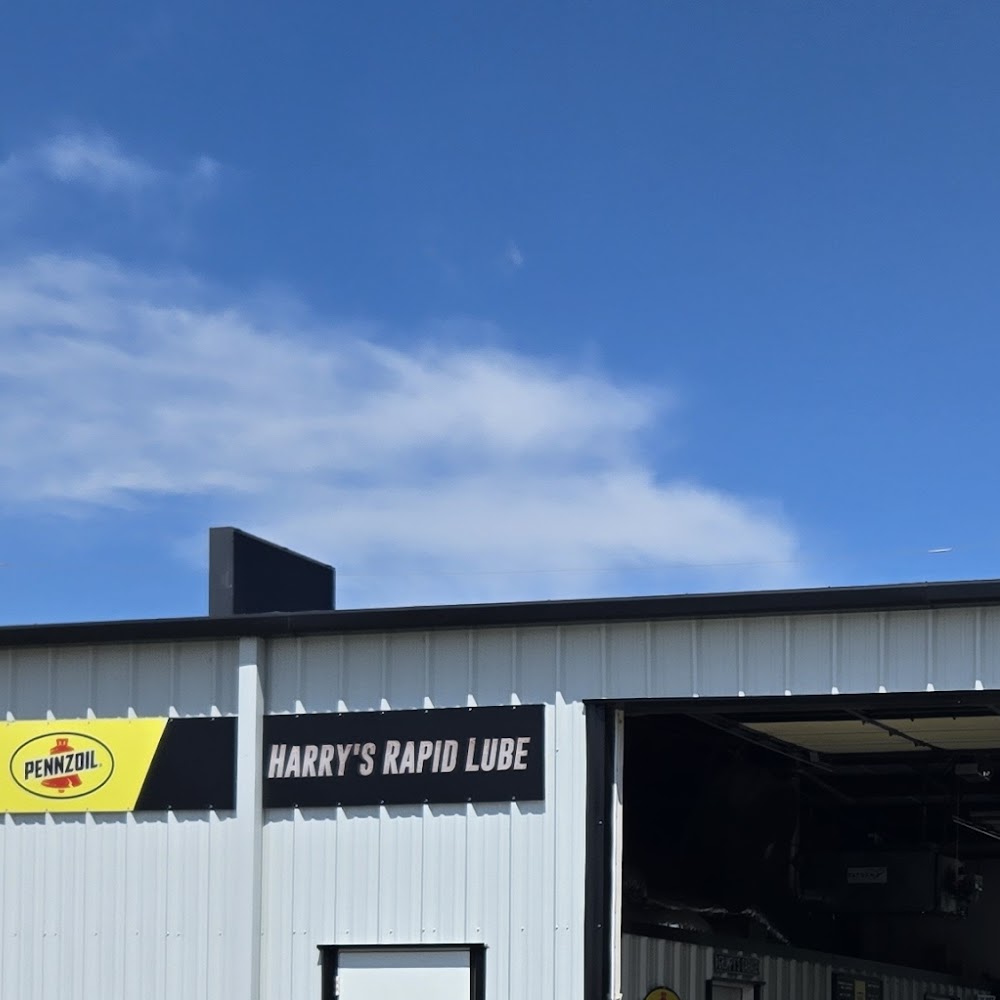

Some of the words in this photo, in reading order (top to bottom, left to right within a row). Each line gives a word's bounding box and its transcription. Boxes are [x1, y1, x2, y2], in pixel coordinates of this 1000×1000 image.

[24, 750, 98, 780] PENNZOIL
[267, 742, 376, 778] HARRY'S
[382, 739, 459, 775] RAPID
[465, 737, 531, 772] LUBE
